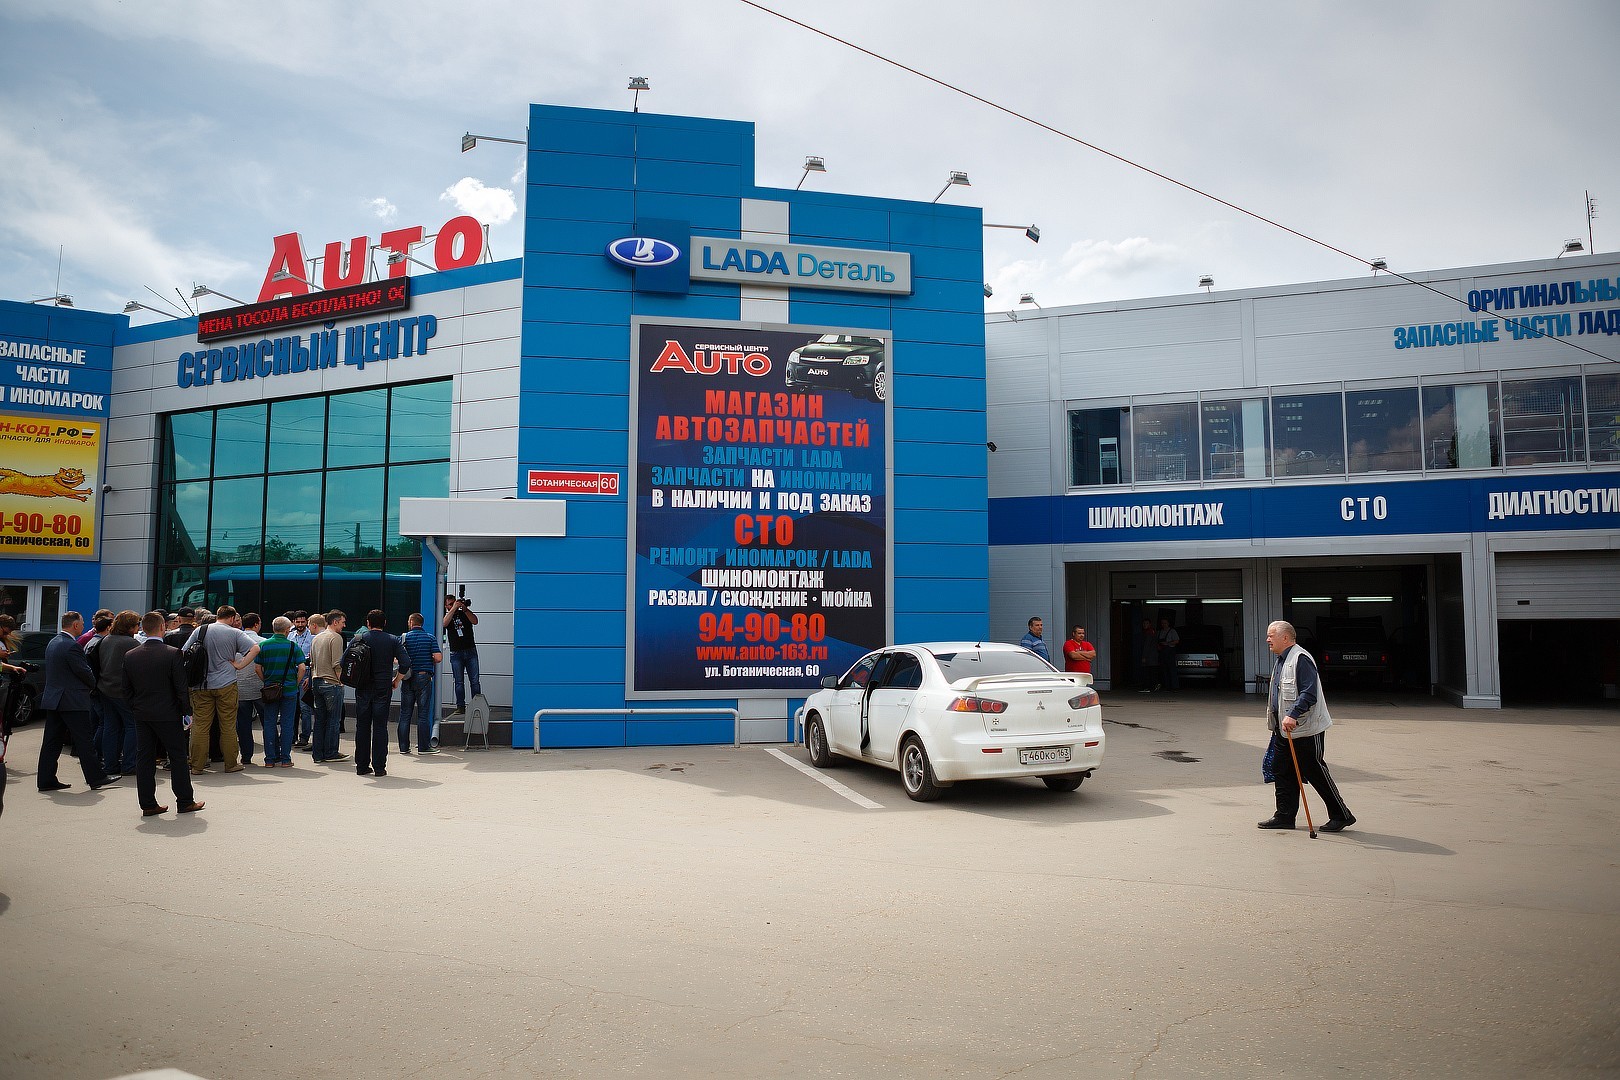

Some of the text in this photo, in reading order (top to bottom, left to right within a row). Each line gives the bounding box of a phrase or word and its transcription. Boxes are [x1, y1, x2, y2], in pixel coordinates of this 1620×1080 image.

[702, 246, 790, 275] LADA
[198, 315, 233, 335] МЕНА
[236, 308, 288, 328] ТОСОЛА
[292, 289, 381, 319] БЕСПЛАТНО!
[1393, 318, 1500, 350] ЗАПАСНЫЕ
[1504, 312, 1572, 341] ЧАСТИ
[0, 340, 86, 365] ЗАПАСНЫЕ
[177, 314, 437, 389] СЕРВИСНЫЙ ЦЕНТР
[695, 343, 769, 353] СЕРВИСНЫЙ ЦЕНТР
[16, 365, 70, 385] ЧАСТИ
[10, 386, 104, 411] ИНОМАРОК
[705, 389, 823, 419] МАГАЗИН
[0, 434, 32, 442] ПЧАСТИ
[54, 438, 96, 447] ИНОМАРОК
[655, 415, 869, 448] АВТОЗАПЧАСТЕЙ
[702, 445, 844, 469] ЗАПЧАСТИ LADA
[530, 477, 617, 490] БОТАНИЧЕСКАЯ 60
[651, 466, 873, 491] ЗАПЧАСТИ НА ИНОМАРКИ
[651, 489, 872, 514] В НАЛИЧИИ И ПОД ЗАКАЗ
[1340, 495, 1388, 521] СТО
[1488, 487, 1620, 520] ДИАГНОСТИ
[1088, 502, 1225, 529] ШИНОМОНТАЖ
[734, 513, 794, 546] СТО
[75, 537, 90, 548] 60
[649, 547, 719, 567] РЕМОНТ
[725, 548, 818, 568] ИНОМАРОК
[832, 550, 873, 569] LADA
[700, 569, 825, 589] ШИНОМОНТАЖ
[648, 589, 707, 606] РАЗВАЛ
[720, 590, 808, 609] СХОЖДЕНИЕ
[821, 587, 873, 608] МОЙКА
[699, 612, 825, 642] 94-90-80
[696, 643, 828, 661] www.auto-163.ru
[704, 664, 820, 678] ул. Ботаническая, 60
